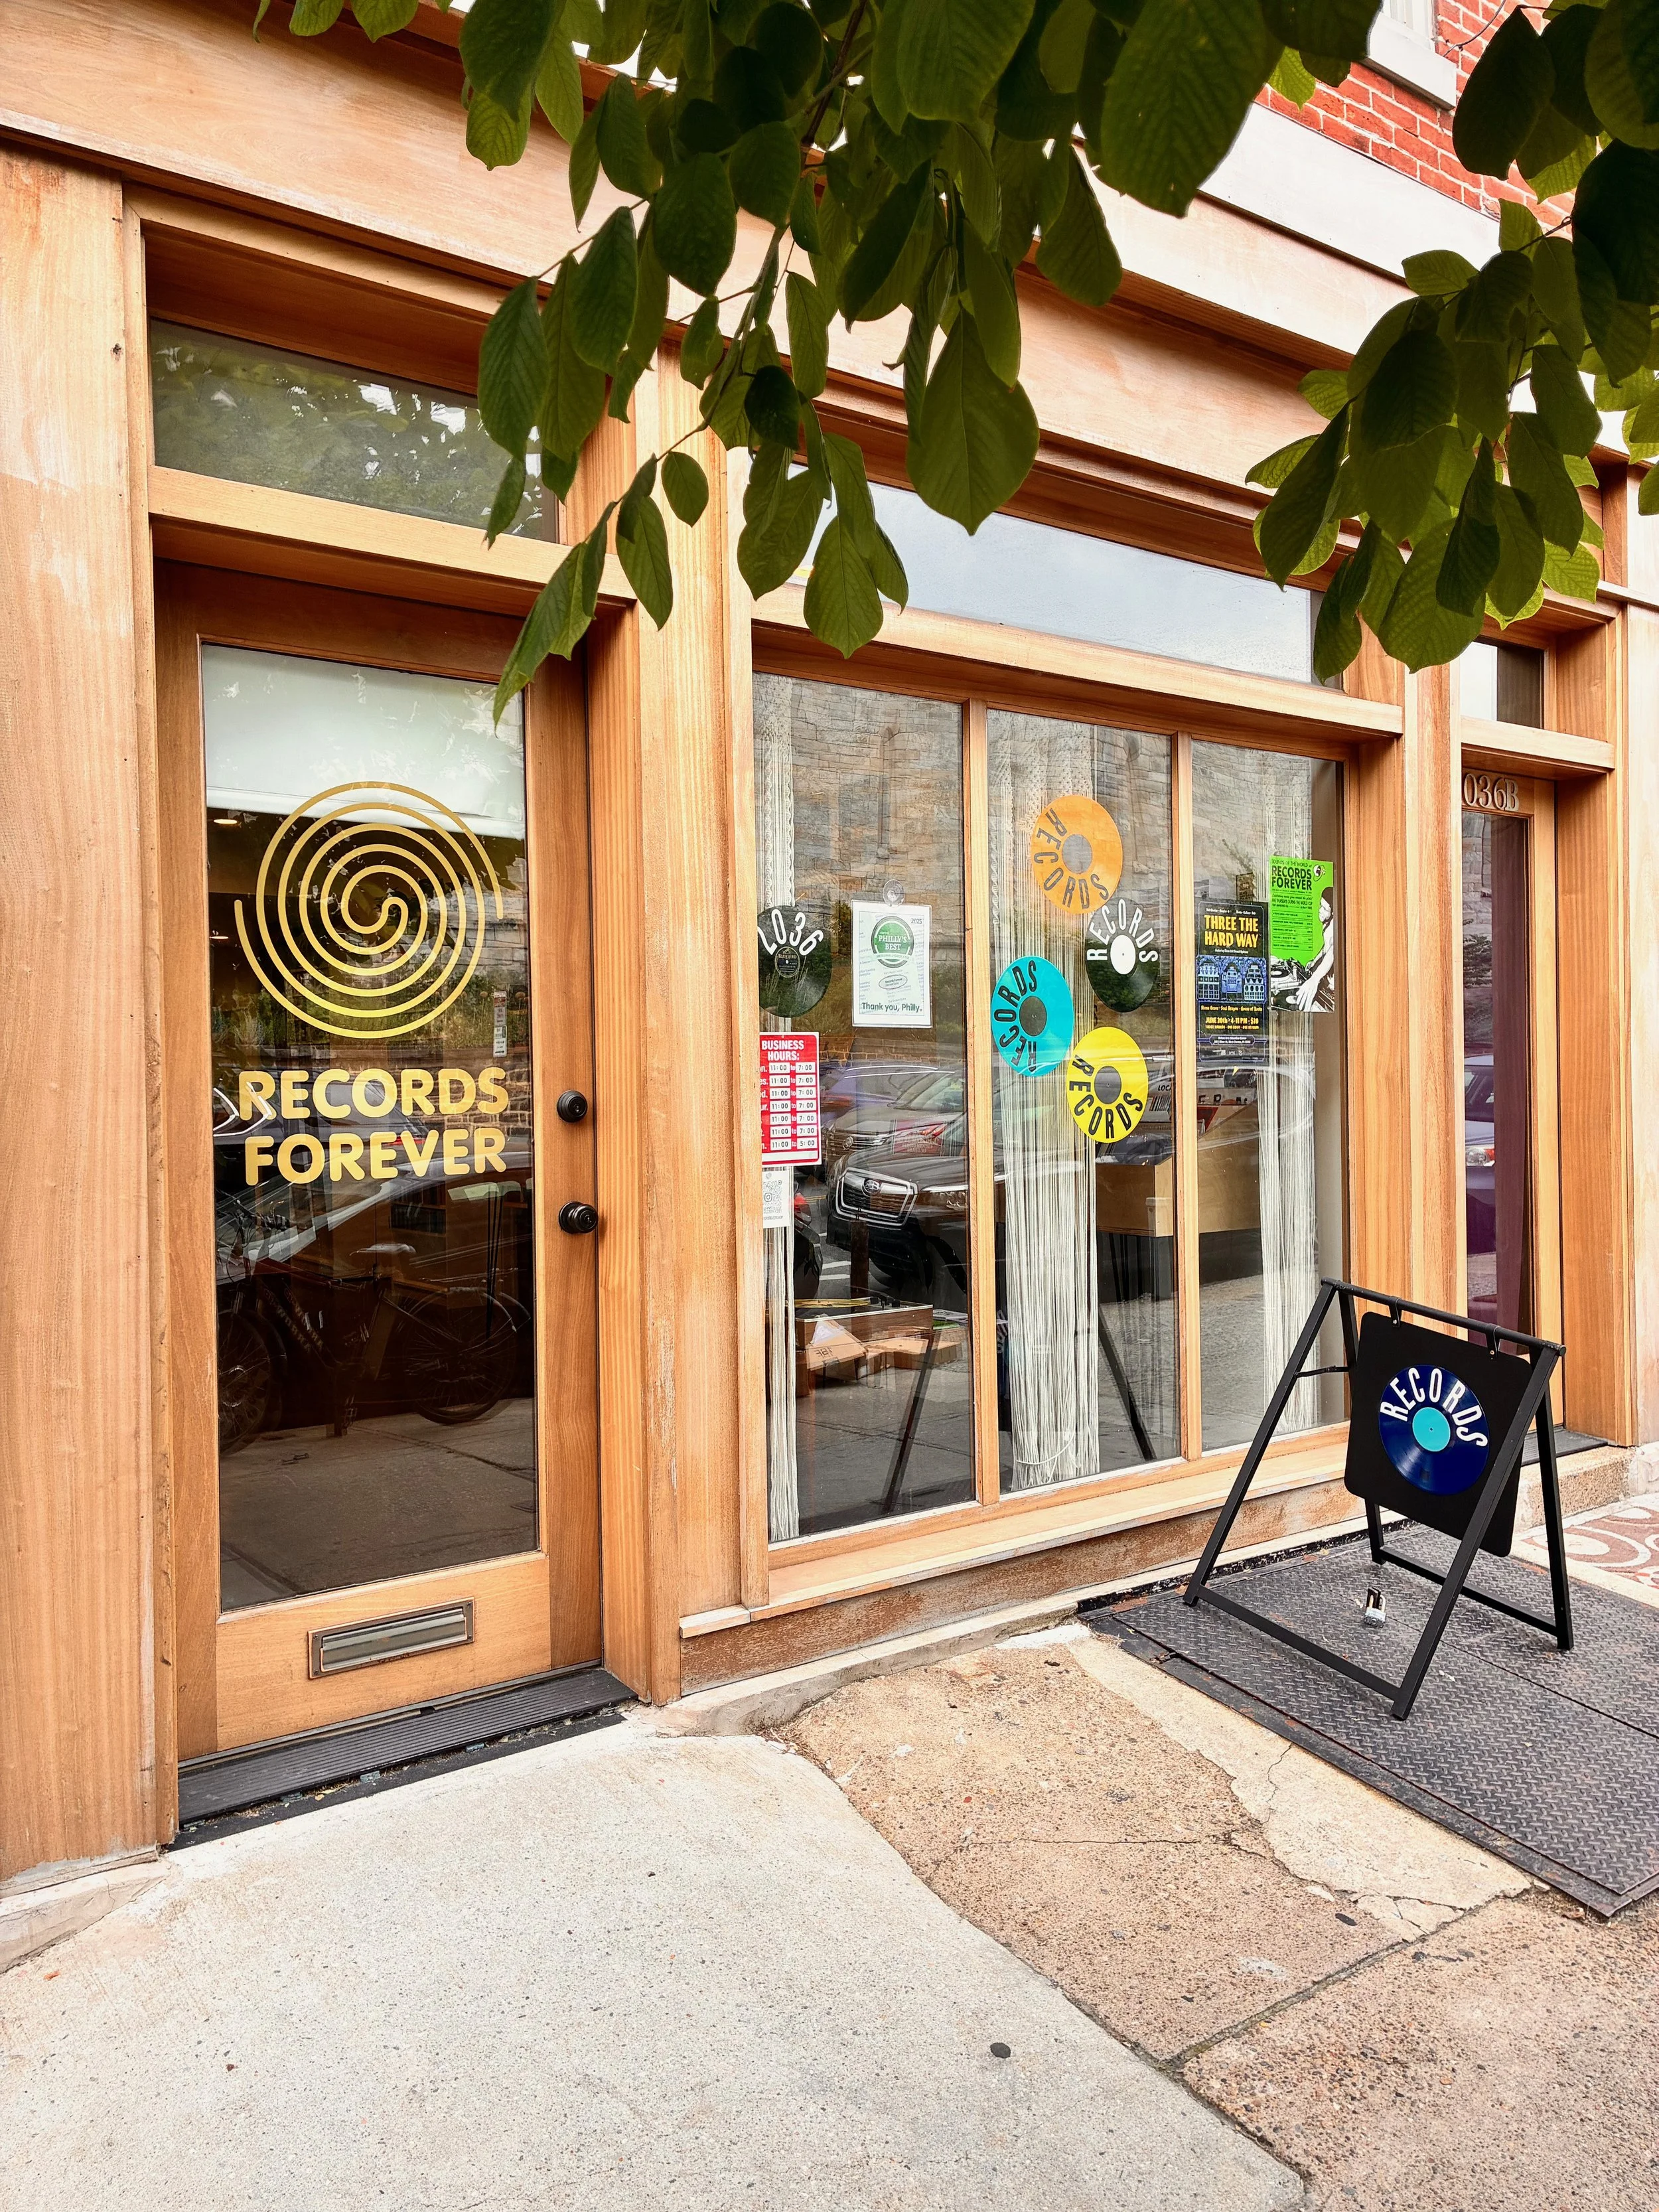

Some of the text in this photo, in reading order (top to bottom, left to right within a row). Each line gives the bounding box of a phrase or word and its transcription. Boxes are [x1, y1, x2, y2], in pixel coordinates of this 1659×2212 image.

[1033, 808, 1109, 909] RECORDS
[1271, 865, 1312, 879] RECORDS
[1271, 877, 1312, 891] FOREVER
[1086, 899, 1159, 963] RECORDS
[1204, 915, 1259, 932] THREE THE
[1204, 931, 1259, 948] HARD WAY
[995, 960, 1037, 1072] RECORDS
[761, 1040, 804, 1050] BUSINESS
[768, 1051, 800, 1061] HOURS:
[239, 1067, 509, 1120] RECORDS
[1069, 1054, 1143, 1139] RECORDS
[245, 1128, 507, 1185] FOREVER
[1380, 1367, 1488, 1447] RECORDS
